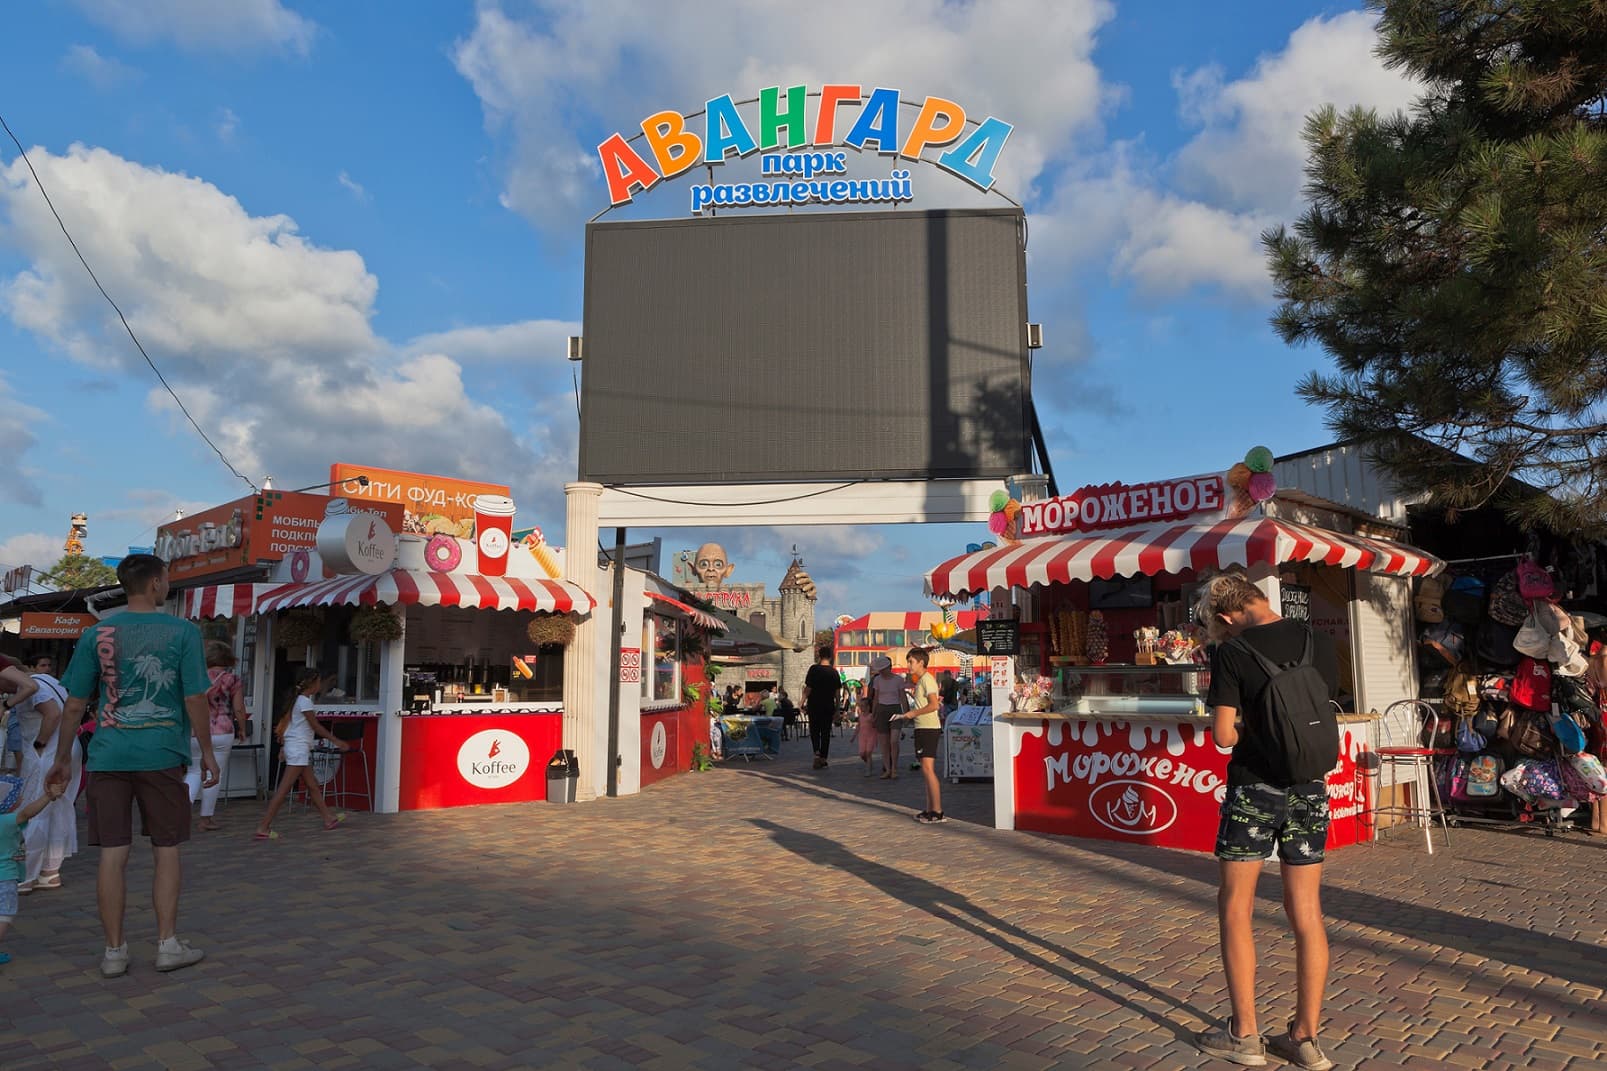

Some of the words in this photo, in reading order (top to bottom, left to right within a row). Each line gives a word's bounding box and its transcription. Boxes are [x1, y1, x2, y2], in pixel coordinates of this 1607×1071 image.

[597, 84, 1014, 205] АВАНГАРД
[761, 151, 848, 179] парк
[690, 170, 913, 213] развлечений
[342, 478, 400, 499] СИТИ
[1021, 476, 1221, 534] МОРОЖЕНОЕ
[358, 540, 385, 559] Koffee
[54, 615, 81, 626] Кафе
[471, 760, 517, 775] Koffee
